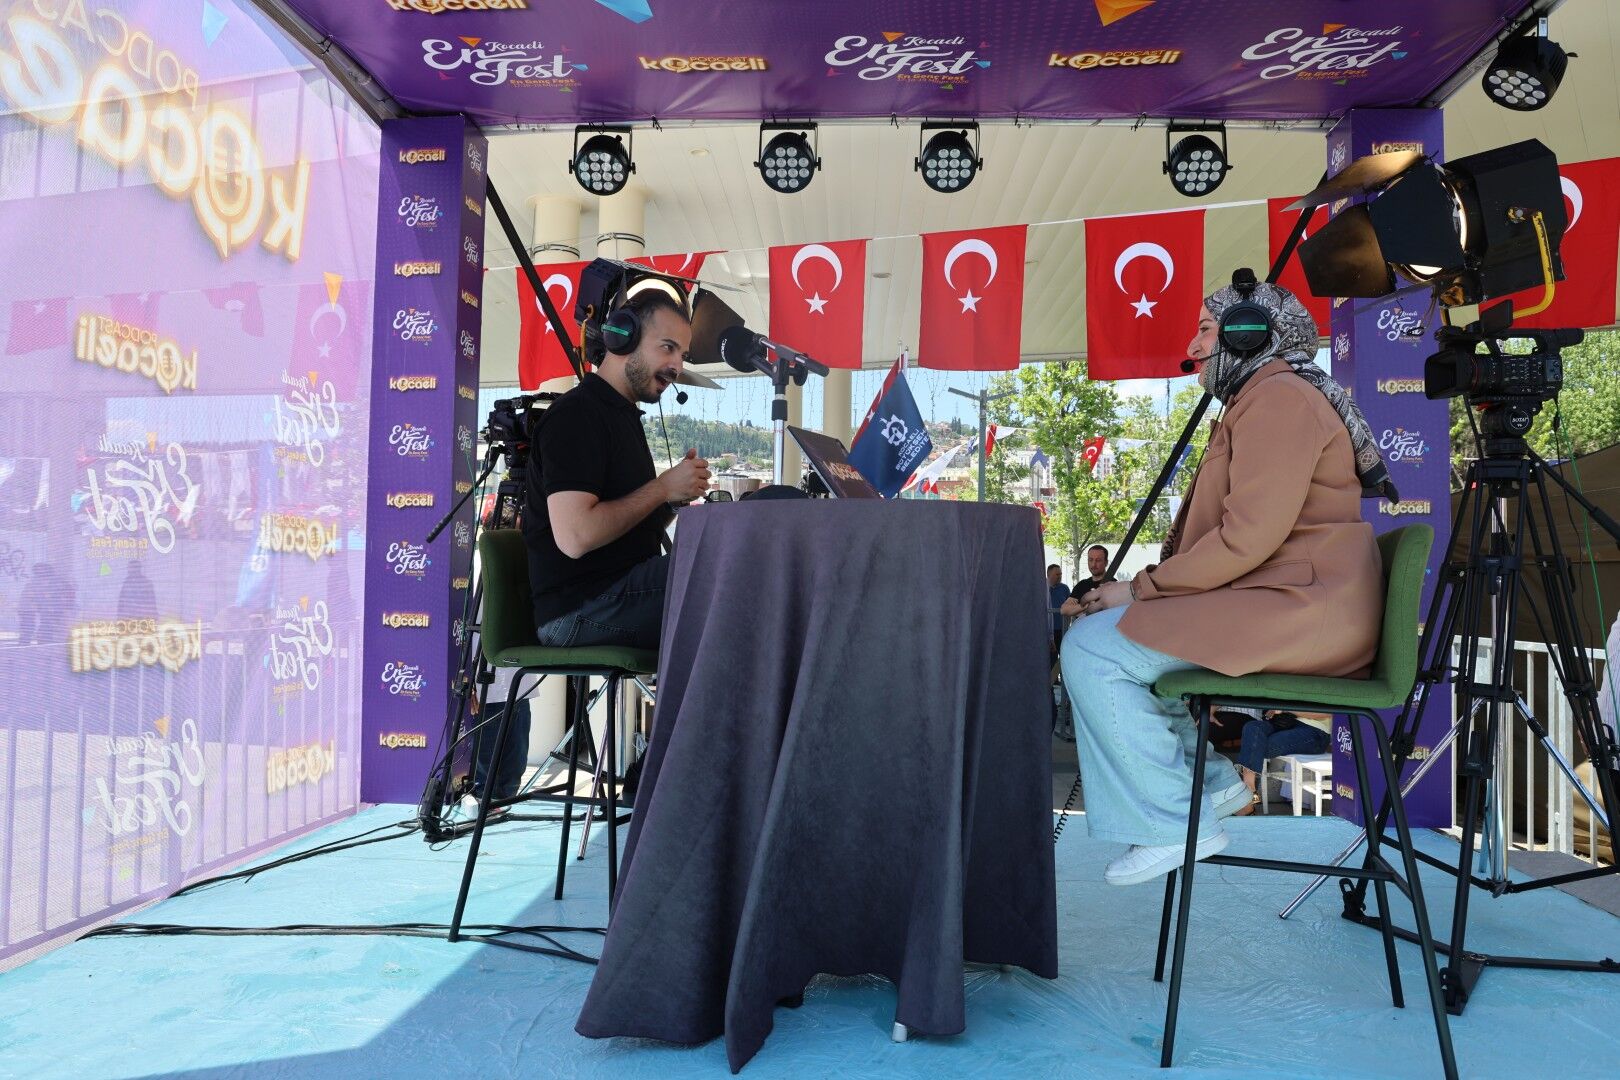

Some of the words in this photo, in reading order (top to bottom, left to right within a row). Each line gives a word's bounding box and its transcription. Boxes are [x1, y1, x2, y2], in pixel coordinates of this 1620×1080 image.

[903, 36, 965, 47] Kocaeli
[469, 54, 574, 86] Fest
[857, 50, 978, 81] Fest
[1260, 41, 1403, 80] Fest
[406, 205, 440, 227] Fest
[401, 319, 434, 340] Fest
[1377, 379, 1425, 395] kocael
[397, 434, 430, 456] Fest
[1389, 440, 1425, 461] Fest
[394, 553, 427, 574] Fest
[389, 674, 423, 694] Fest
